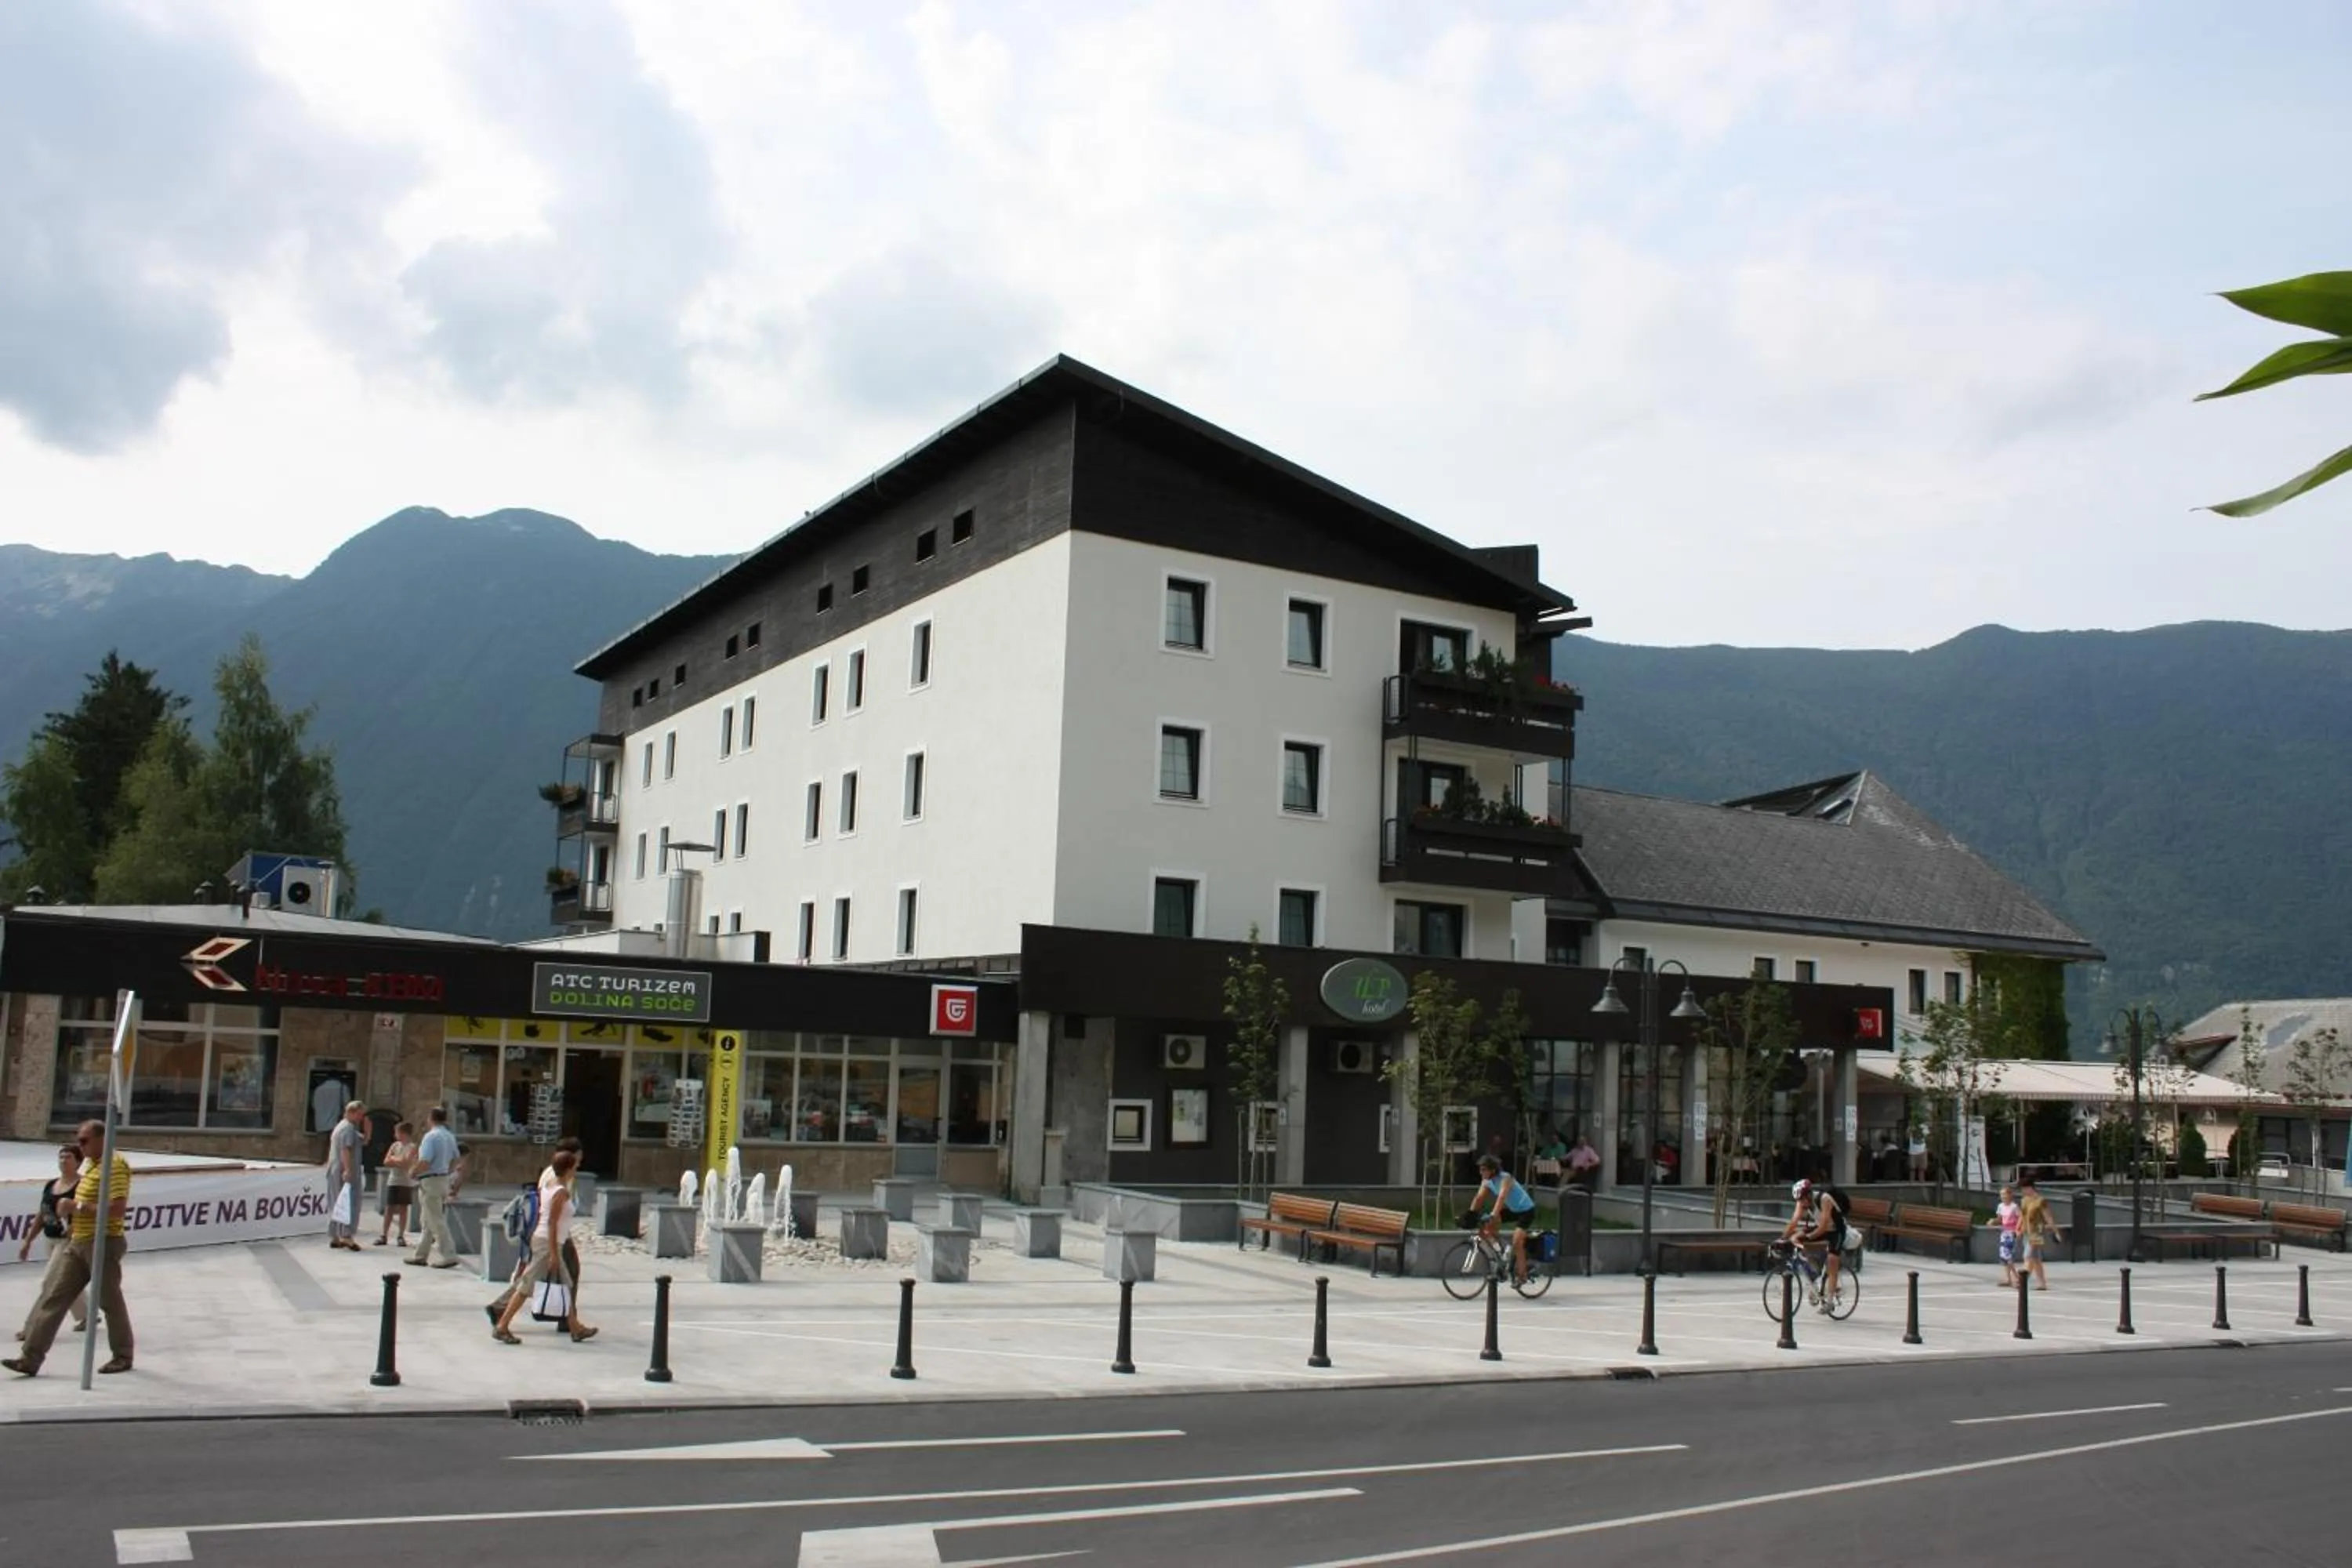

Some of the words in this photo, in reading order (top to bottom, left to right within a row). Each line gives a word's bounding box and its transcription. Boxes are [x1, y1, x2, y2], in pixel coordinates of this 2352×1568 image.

[550, 991, 633, 1008] DOLINA
[551, 974, 592, 989] ATC
[720, 1077, 731, 1116] AGENCY
[717, 1120, 729, 1160] TOURIST
[124, 1202, 210, 1231] EDITVE
[216, 1199, 247, 1223] NA
[254, 1186, 328, 1221] BOVŠK
